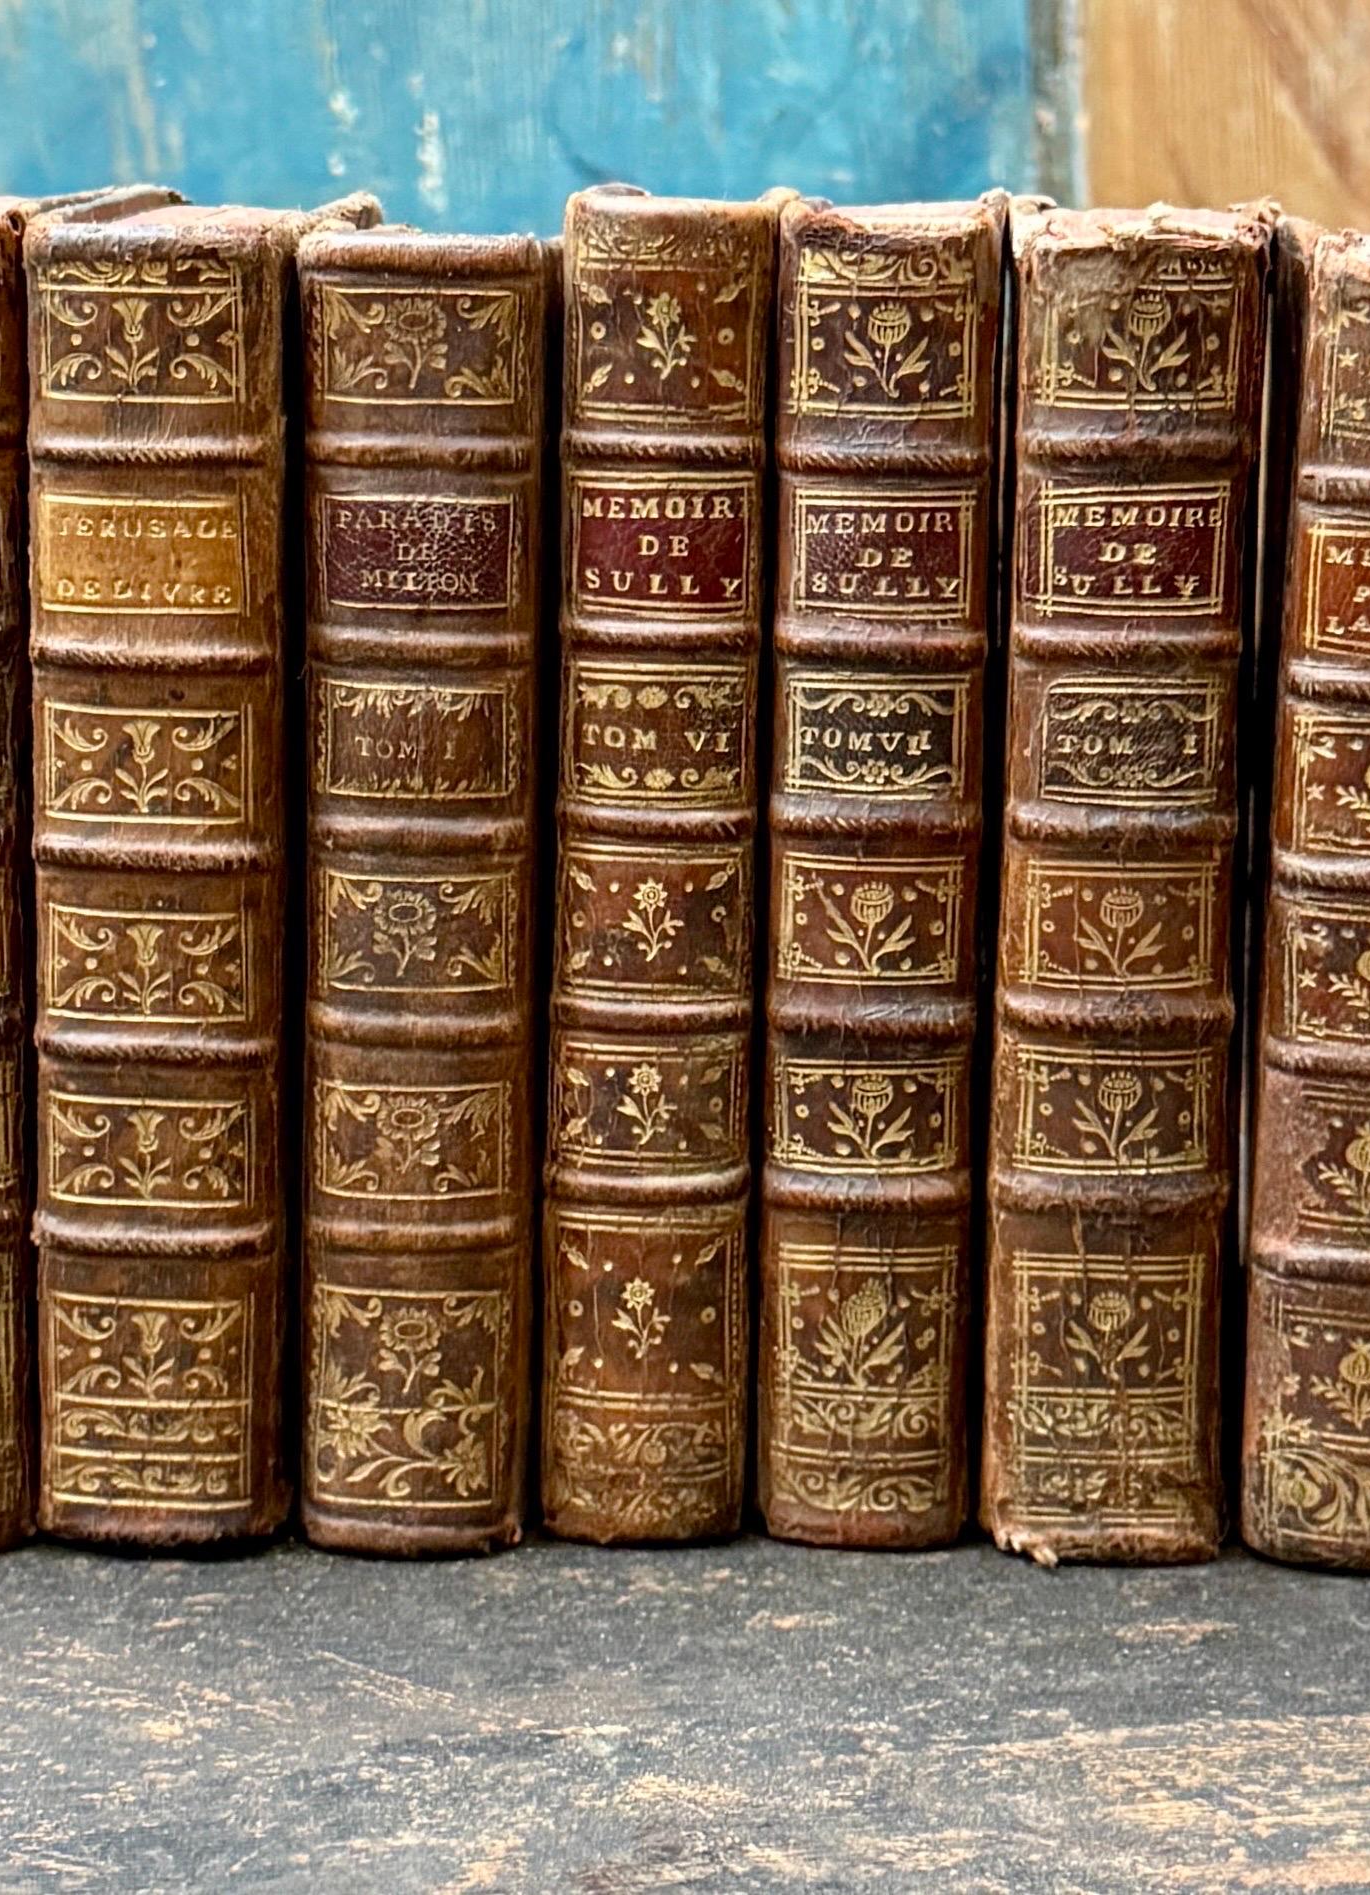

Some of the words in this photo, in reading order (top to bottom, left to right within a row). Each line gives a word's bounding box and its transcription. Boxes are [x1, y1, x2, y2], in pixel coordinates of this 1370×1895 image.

[638, 534, 690, 557] DE
[854, 547, 913, 568] DE
[1098, 541, 1157, 565] DE
[584, 567, 742, 598] SULLY
[811, 572, 961, 598] SULLY
[1053, 566, 1200, 597] SULLY
[355, 736, 417, 759] TOM
[443, 740, 456, 760] I
[582, 723, 657, 751] TOM
[684, 731, 731, 752] VI
[1056, 734, 1134, 755] TOM
[1182, 734, 1198, 755] I
